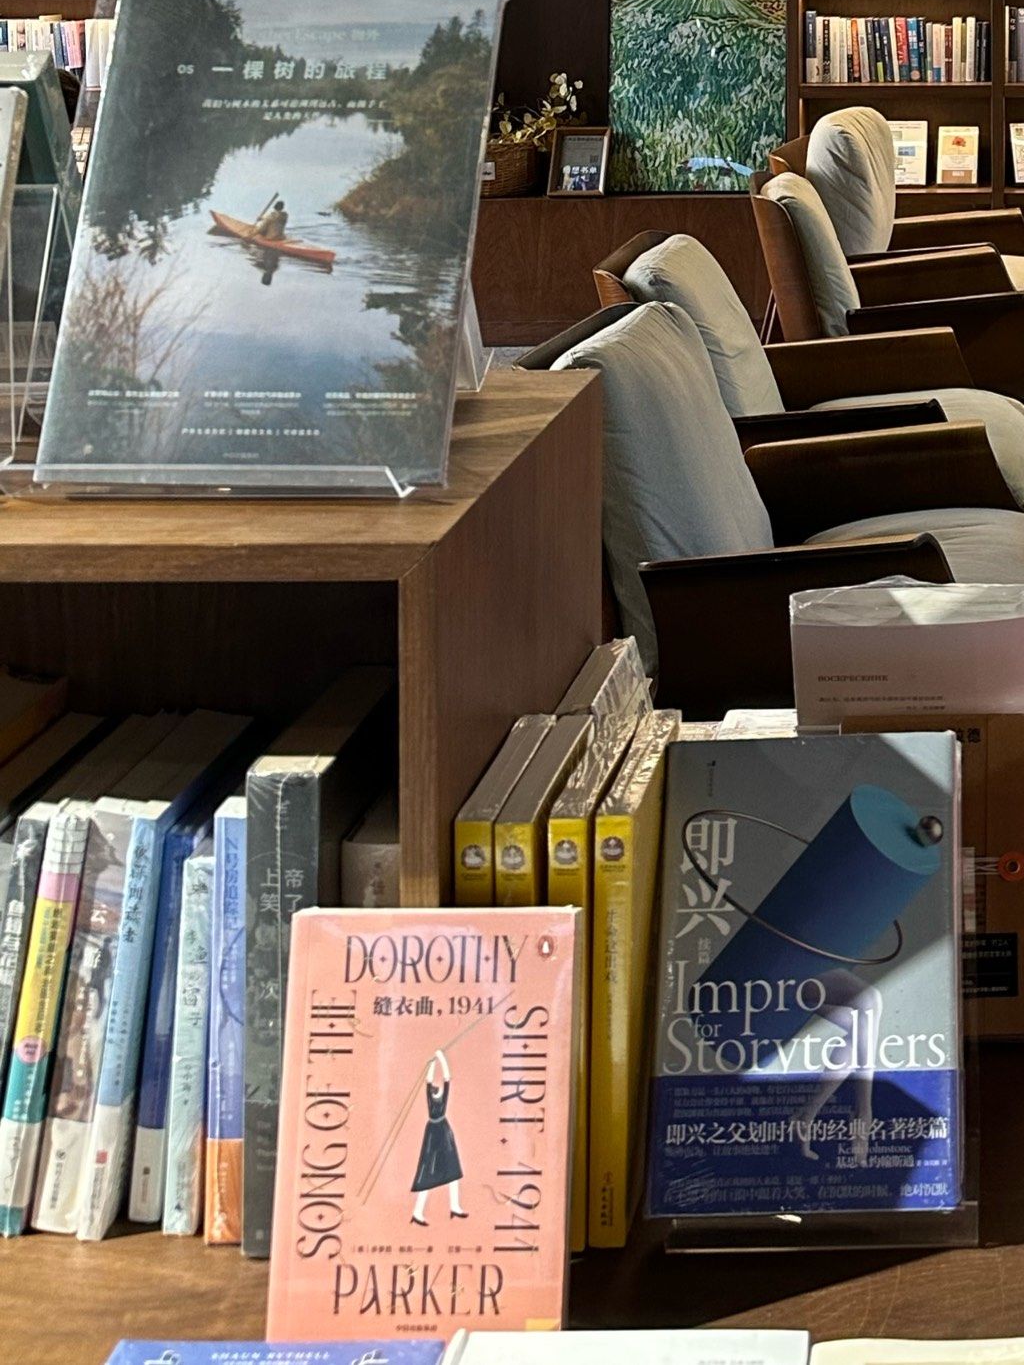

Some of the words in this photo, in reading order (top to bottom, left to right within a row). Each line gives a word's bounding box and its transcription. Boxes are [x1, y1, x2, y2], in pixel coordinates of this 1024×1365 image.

[211, 60, 387, 81] 一棵树的旅程
[674, 816, 738, 940] 即兴
[344, 934, 529, 984] DOROTHY
[308, 989, 357, 1064] THE
[673, 960, 827, 1037] Impro
[693, 1013, 722, 1039] for
[662, 1009, 947, 1076] Storytellers
[304, 1074, 350, 1132] OF
[665, 1115, 949, 1146] 即兴之父划时代的经典名著续篇
[296, 1142, 348, 1261] SONG
[493, 1161, 543, 1253] 1941
[333, 1263, 504, 1316] PARKER
